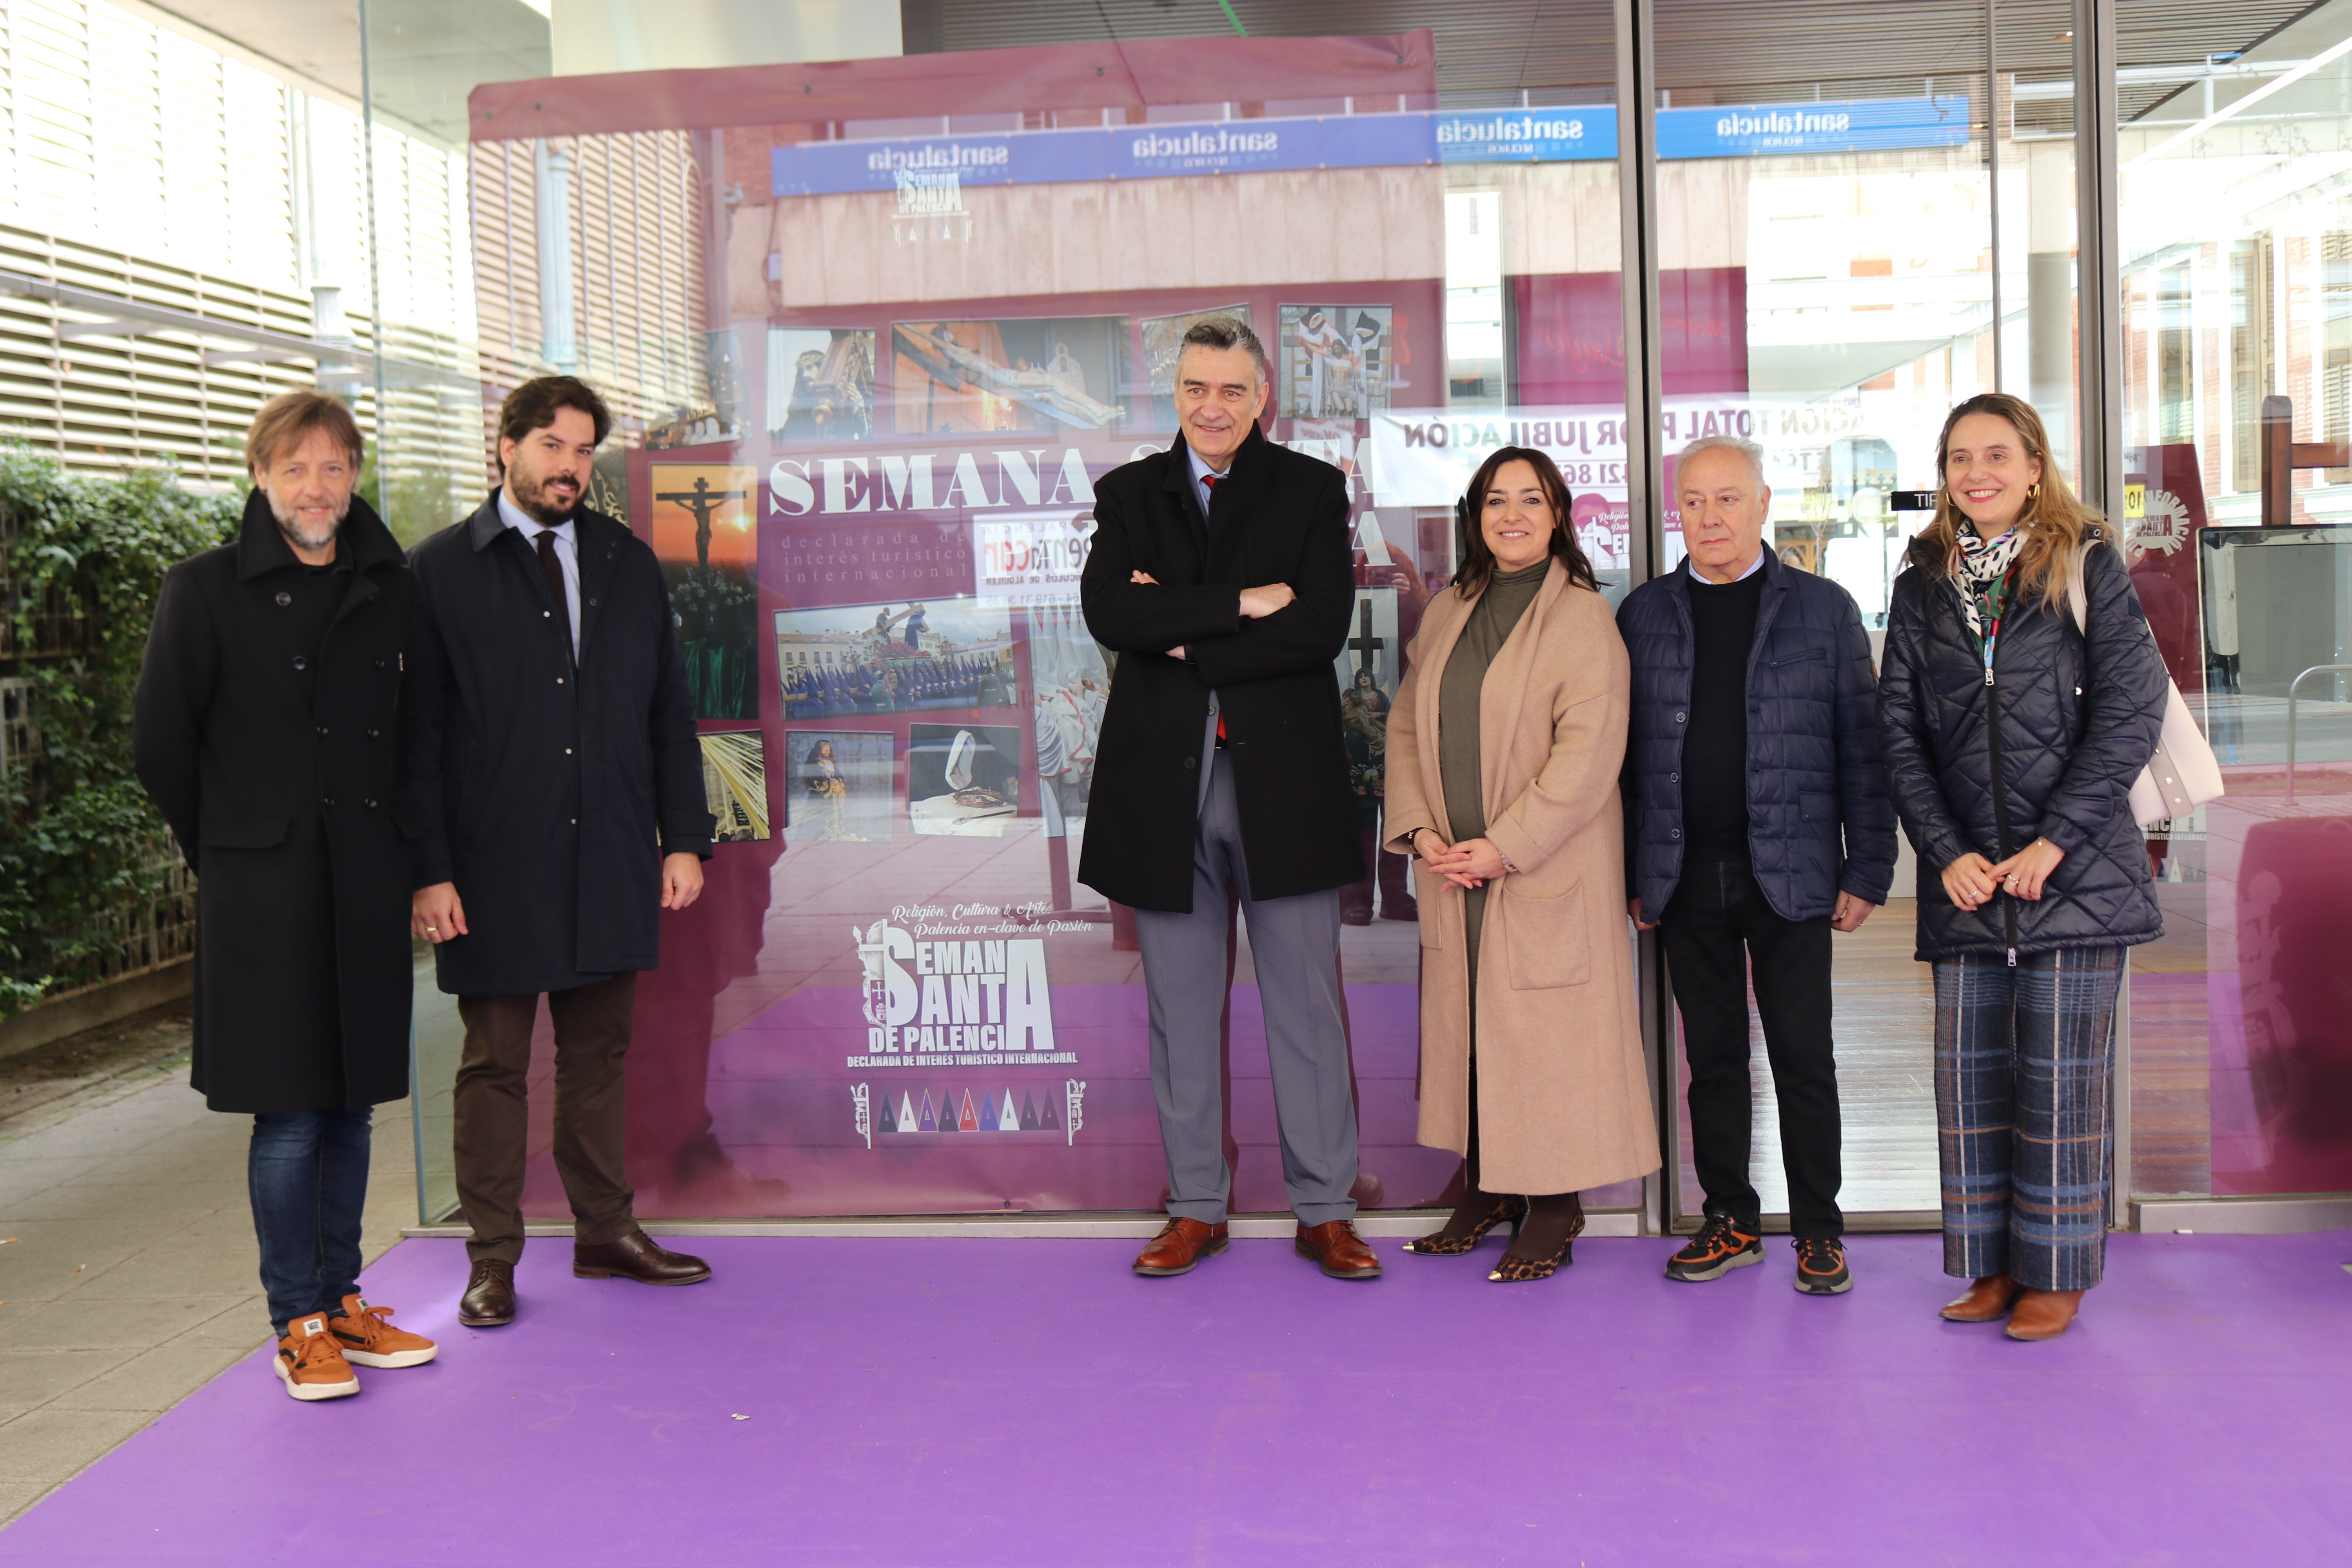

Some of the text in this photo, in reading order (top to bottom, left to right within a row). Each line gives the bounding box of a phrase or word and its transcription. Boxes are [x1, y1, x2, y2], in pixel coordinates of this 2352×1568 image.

[769, 448, 1097, 517] SEMANA
[782, 530, 965, 548] declarada de
[785, 547, 965, 566] interés turístico
[785, 563, 966, 583] internacional
[892, 901, 1051, 924] Religión, Cultura & Arte:
[914, 920, 1093, 939] Palencia en-clave de Pasión
[868, 1025, 1055, 1053] DE PALENCIA
[847, 1052, 1078, 1067] DECLARADA DE INTERÉS TURÍSTICO INTERNACIONAL
